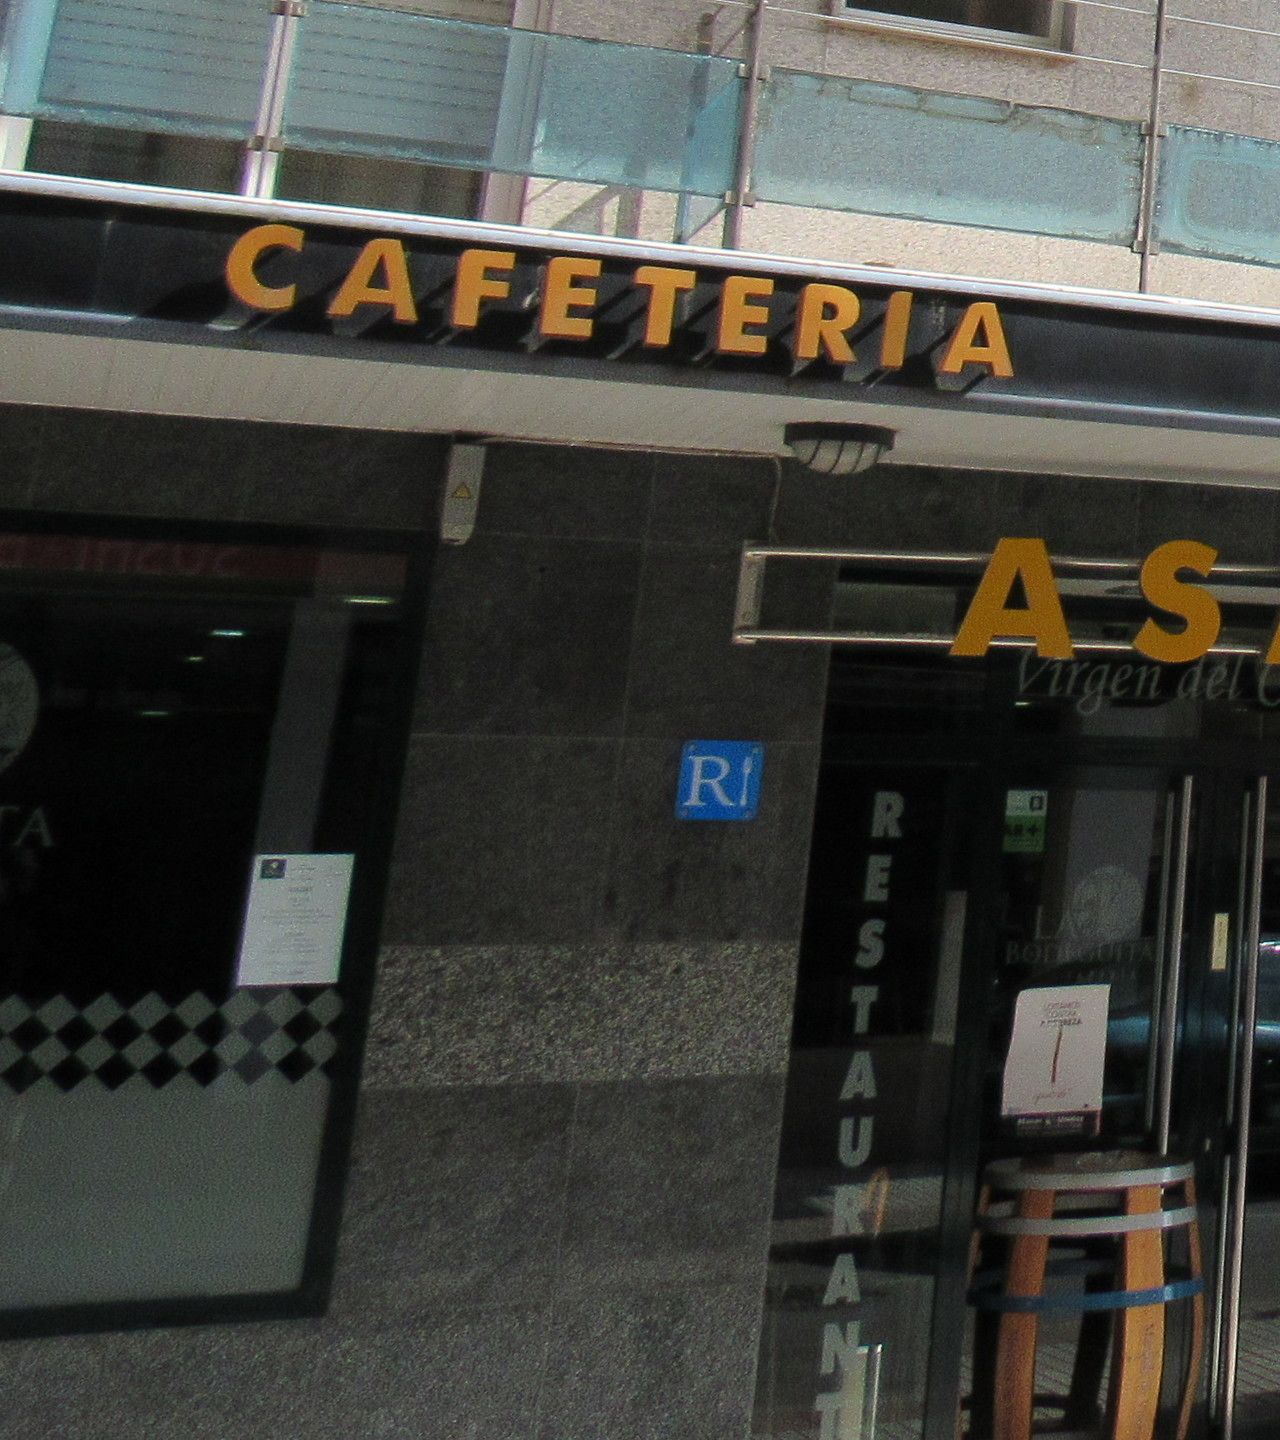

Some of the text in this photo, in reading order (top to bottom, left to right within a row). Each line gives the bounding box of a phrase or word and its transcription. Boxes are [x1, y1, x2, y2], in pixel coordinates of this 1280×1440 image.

[225, 224, 1015, 378] CAFETERIA
[1015, 645, 1163, 714] Virgen
[1177, 650, 1242, 701] del
